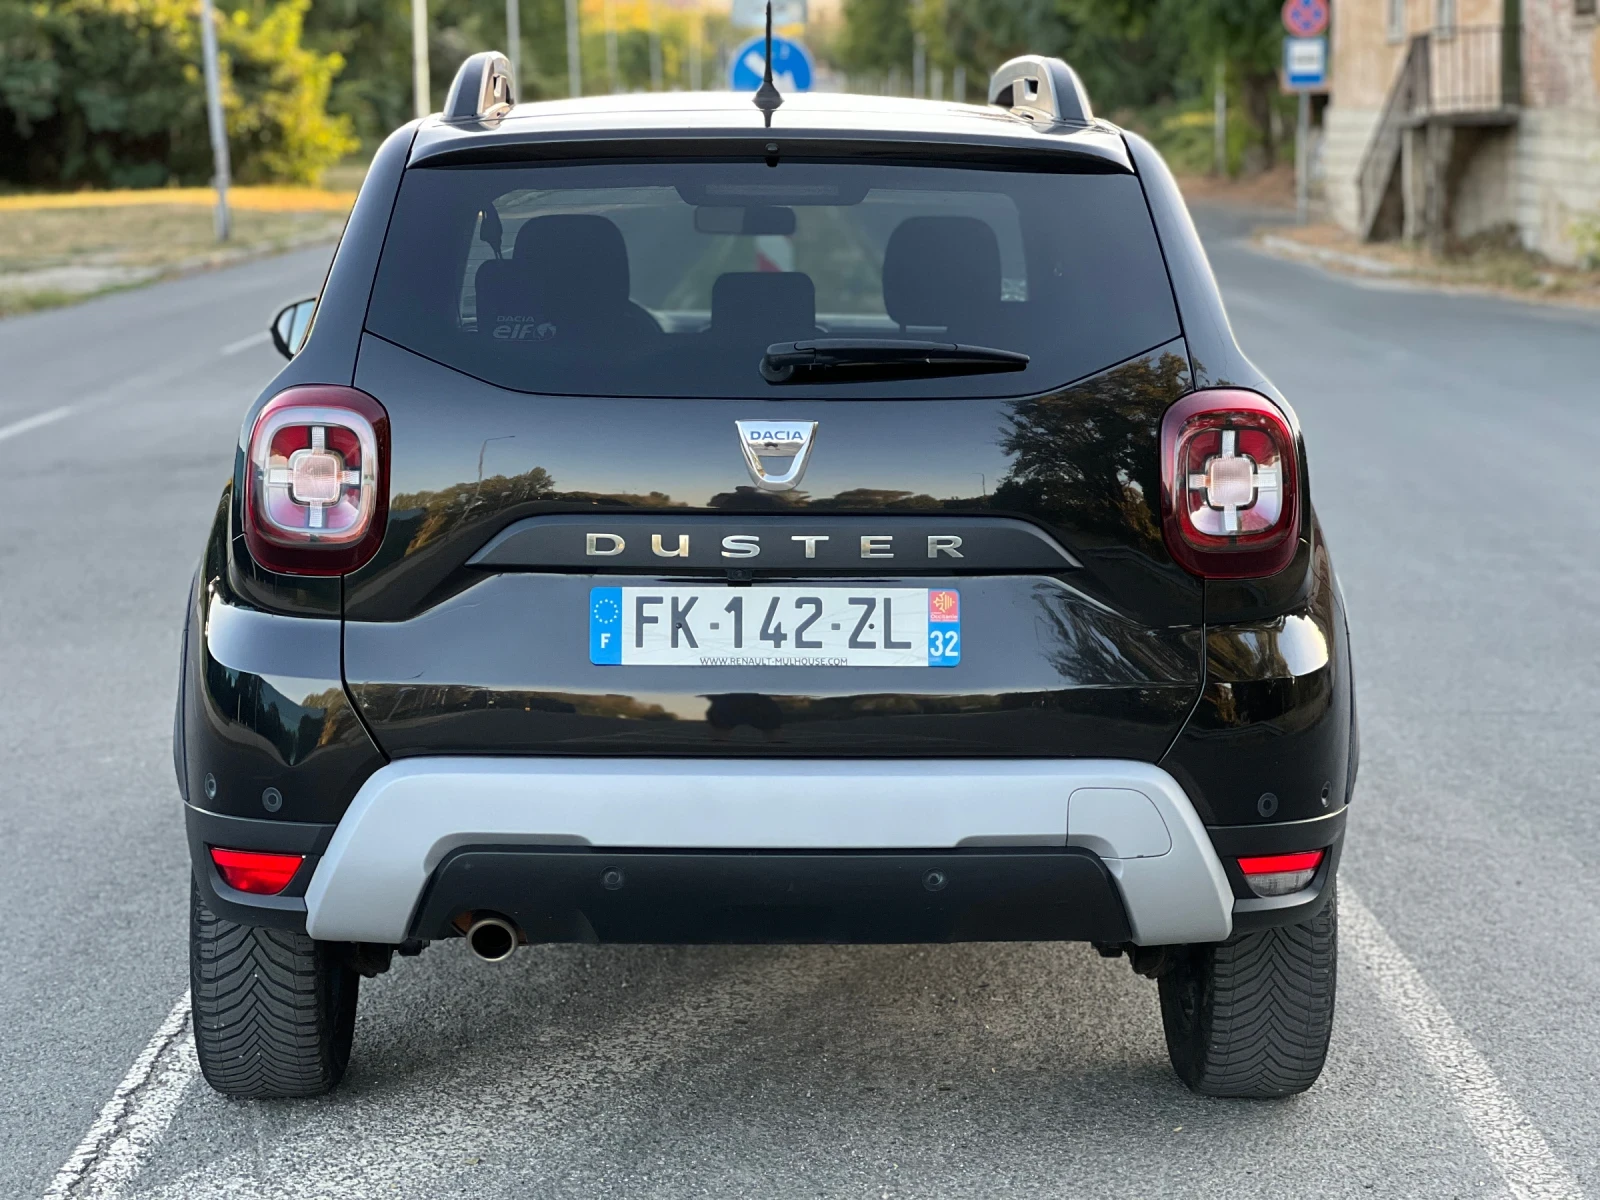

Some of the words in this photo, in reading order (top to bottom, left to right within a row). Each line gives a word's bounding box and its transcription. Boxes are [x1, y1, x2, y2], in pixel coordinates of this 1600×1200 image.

[497, 315, 535, 323] DACIA
[750, 430, 804, 441] DACIA
[585, 533, 965, 559] DUSTER
[634, 596, 912, 650] FK-142-ZL
[599, 632, 612, 649] F
[929, 630, 959, 657] 32
[699, 656, 848, 667] WWW.RENAULT-MULHOUSE.COM
